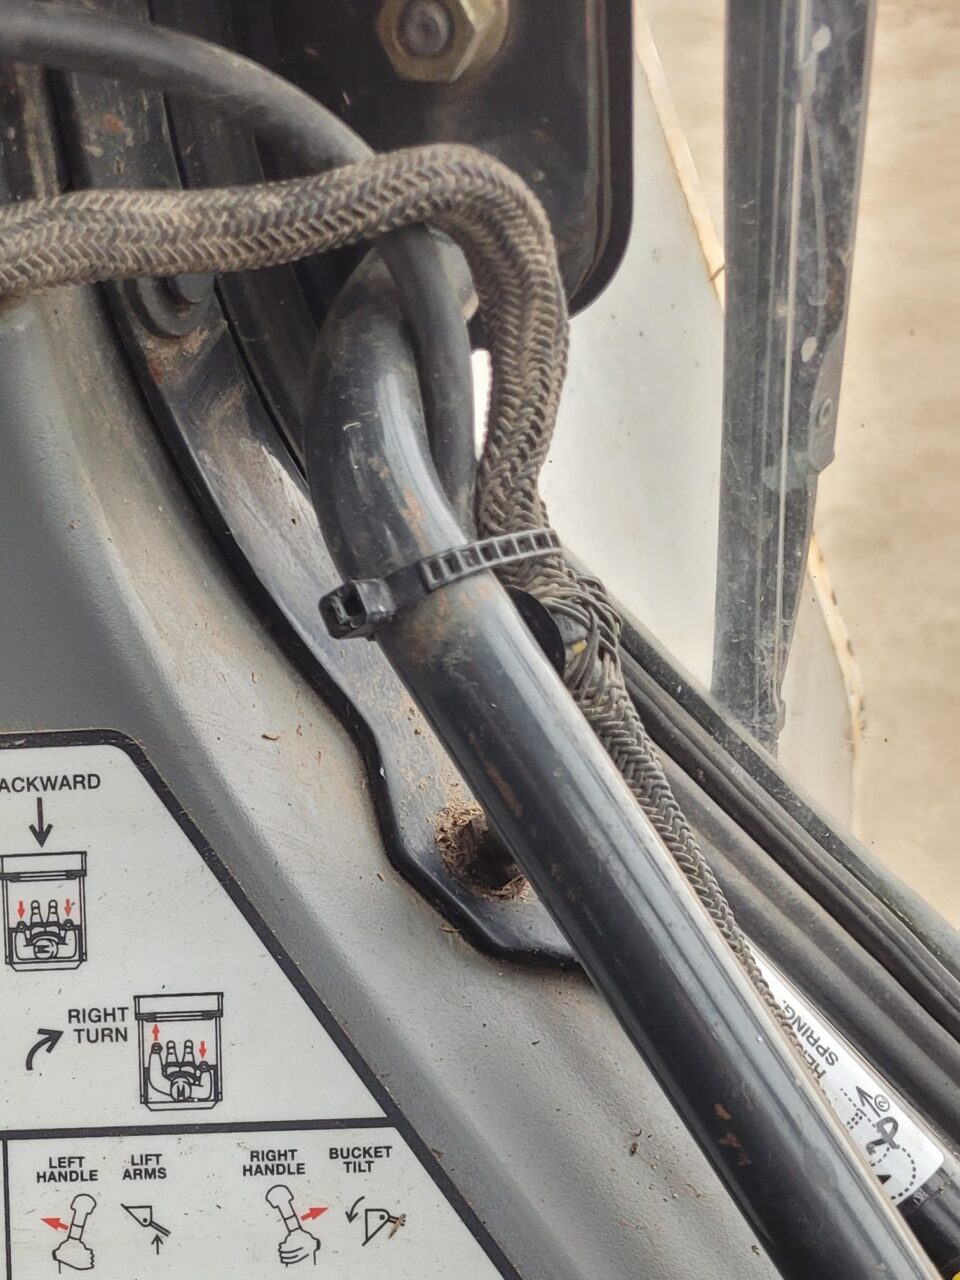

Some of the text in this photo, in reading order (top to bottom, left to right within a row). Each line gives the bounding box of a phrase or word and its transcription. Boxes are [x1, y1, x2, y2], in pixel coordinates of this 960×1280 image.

[68, 1007, 129, 1024] RIGHT
[73, 1027, 127, 1043] TURN
[250, 1149, 298, 1162] RIGHT
[329, 1146, 392, 1160] BUCKET
[49, 1156, 85, 1169] LEFT
[131, 1154, 162, 1166] LIFT
[343, 1160, 374, 1173] TILT
[122, 1167, 167, 1180] ARMS
[243, 1163, 305, 1176] HANDLE
[37, 1170, 98, 1183] HANDLE
